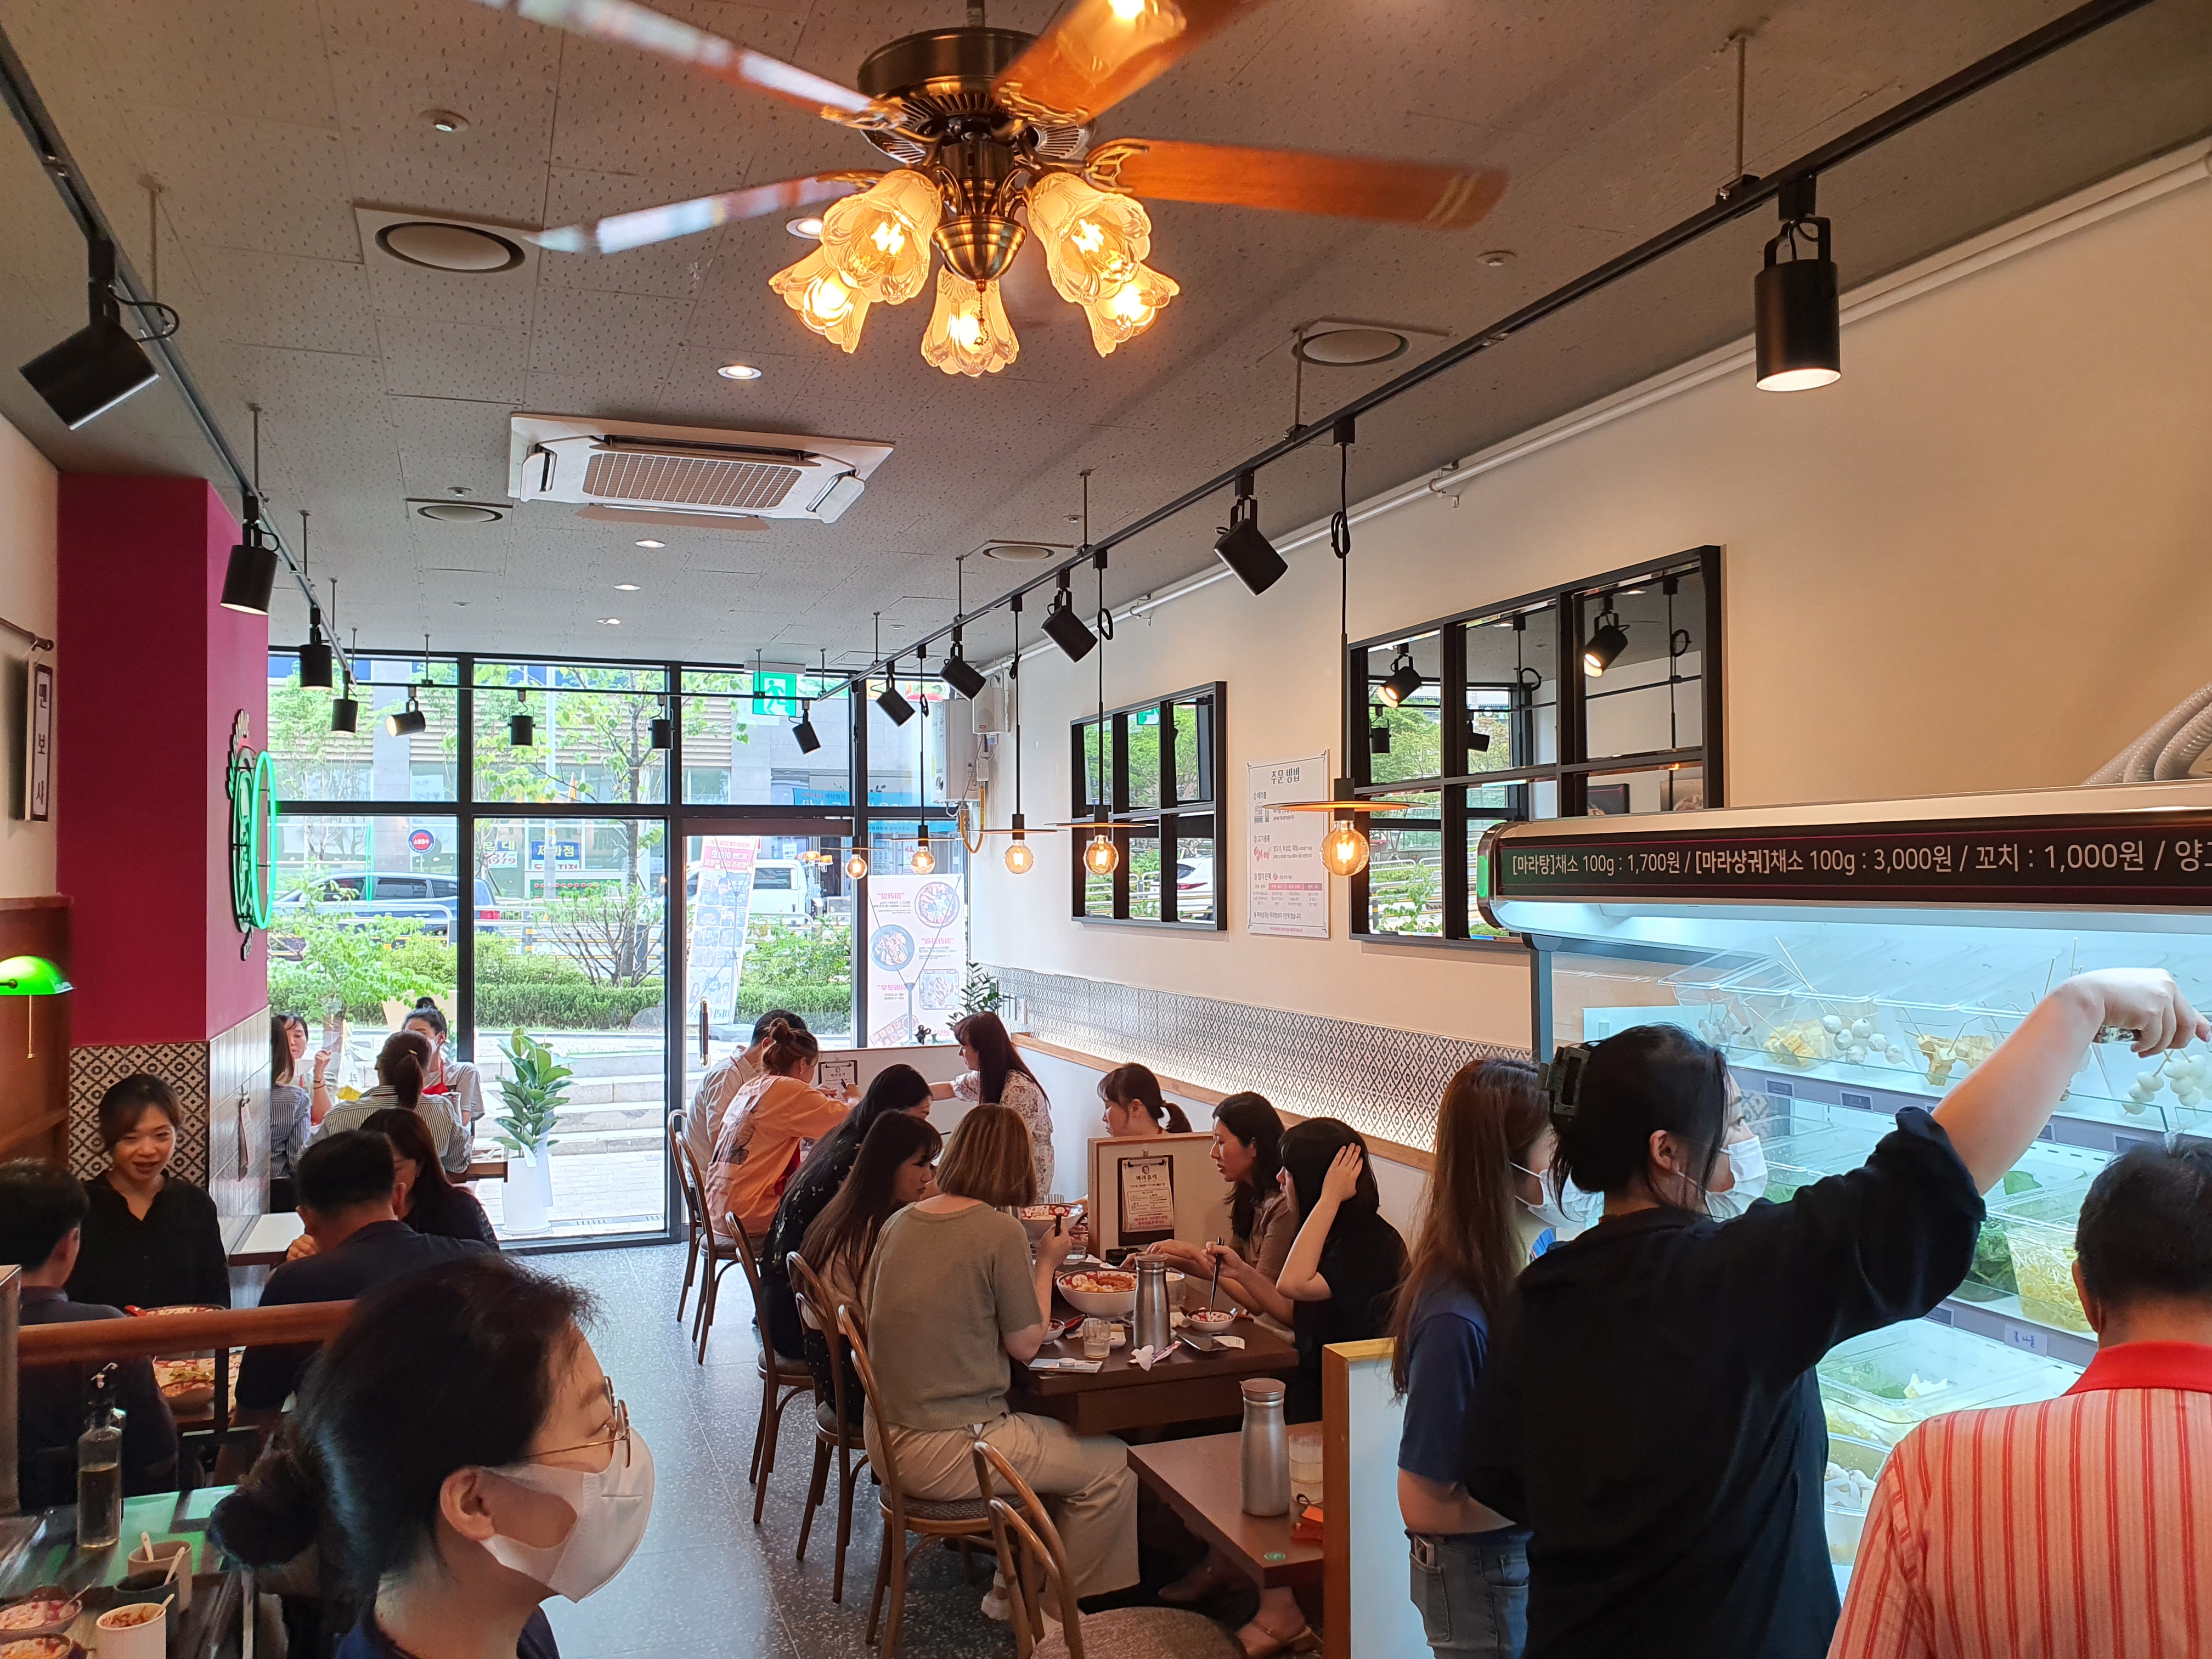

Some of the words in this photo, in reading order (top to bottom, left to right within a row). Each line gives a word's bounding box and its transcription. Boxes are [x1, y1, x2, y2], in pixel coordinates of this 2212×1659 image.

[1271, 769, 1284, 785] 주문
[1286, 767, 1300, 783] 방법
[1513, 854, 1579, 876] [마라탕]채소
[1583, 855, 1615, 876] 100g
[1627, 851, 1680, 875] 1,700원
[1695, 848, 1804, 874] [마라샹궈]채소
[1809, 849, 1855, 876] 100g
[1874, 845, 1952, 874] 3,000원
[1975, 843, 2019, 872] 꼬치
[2044, 840, 2145, 873] 1,000원
